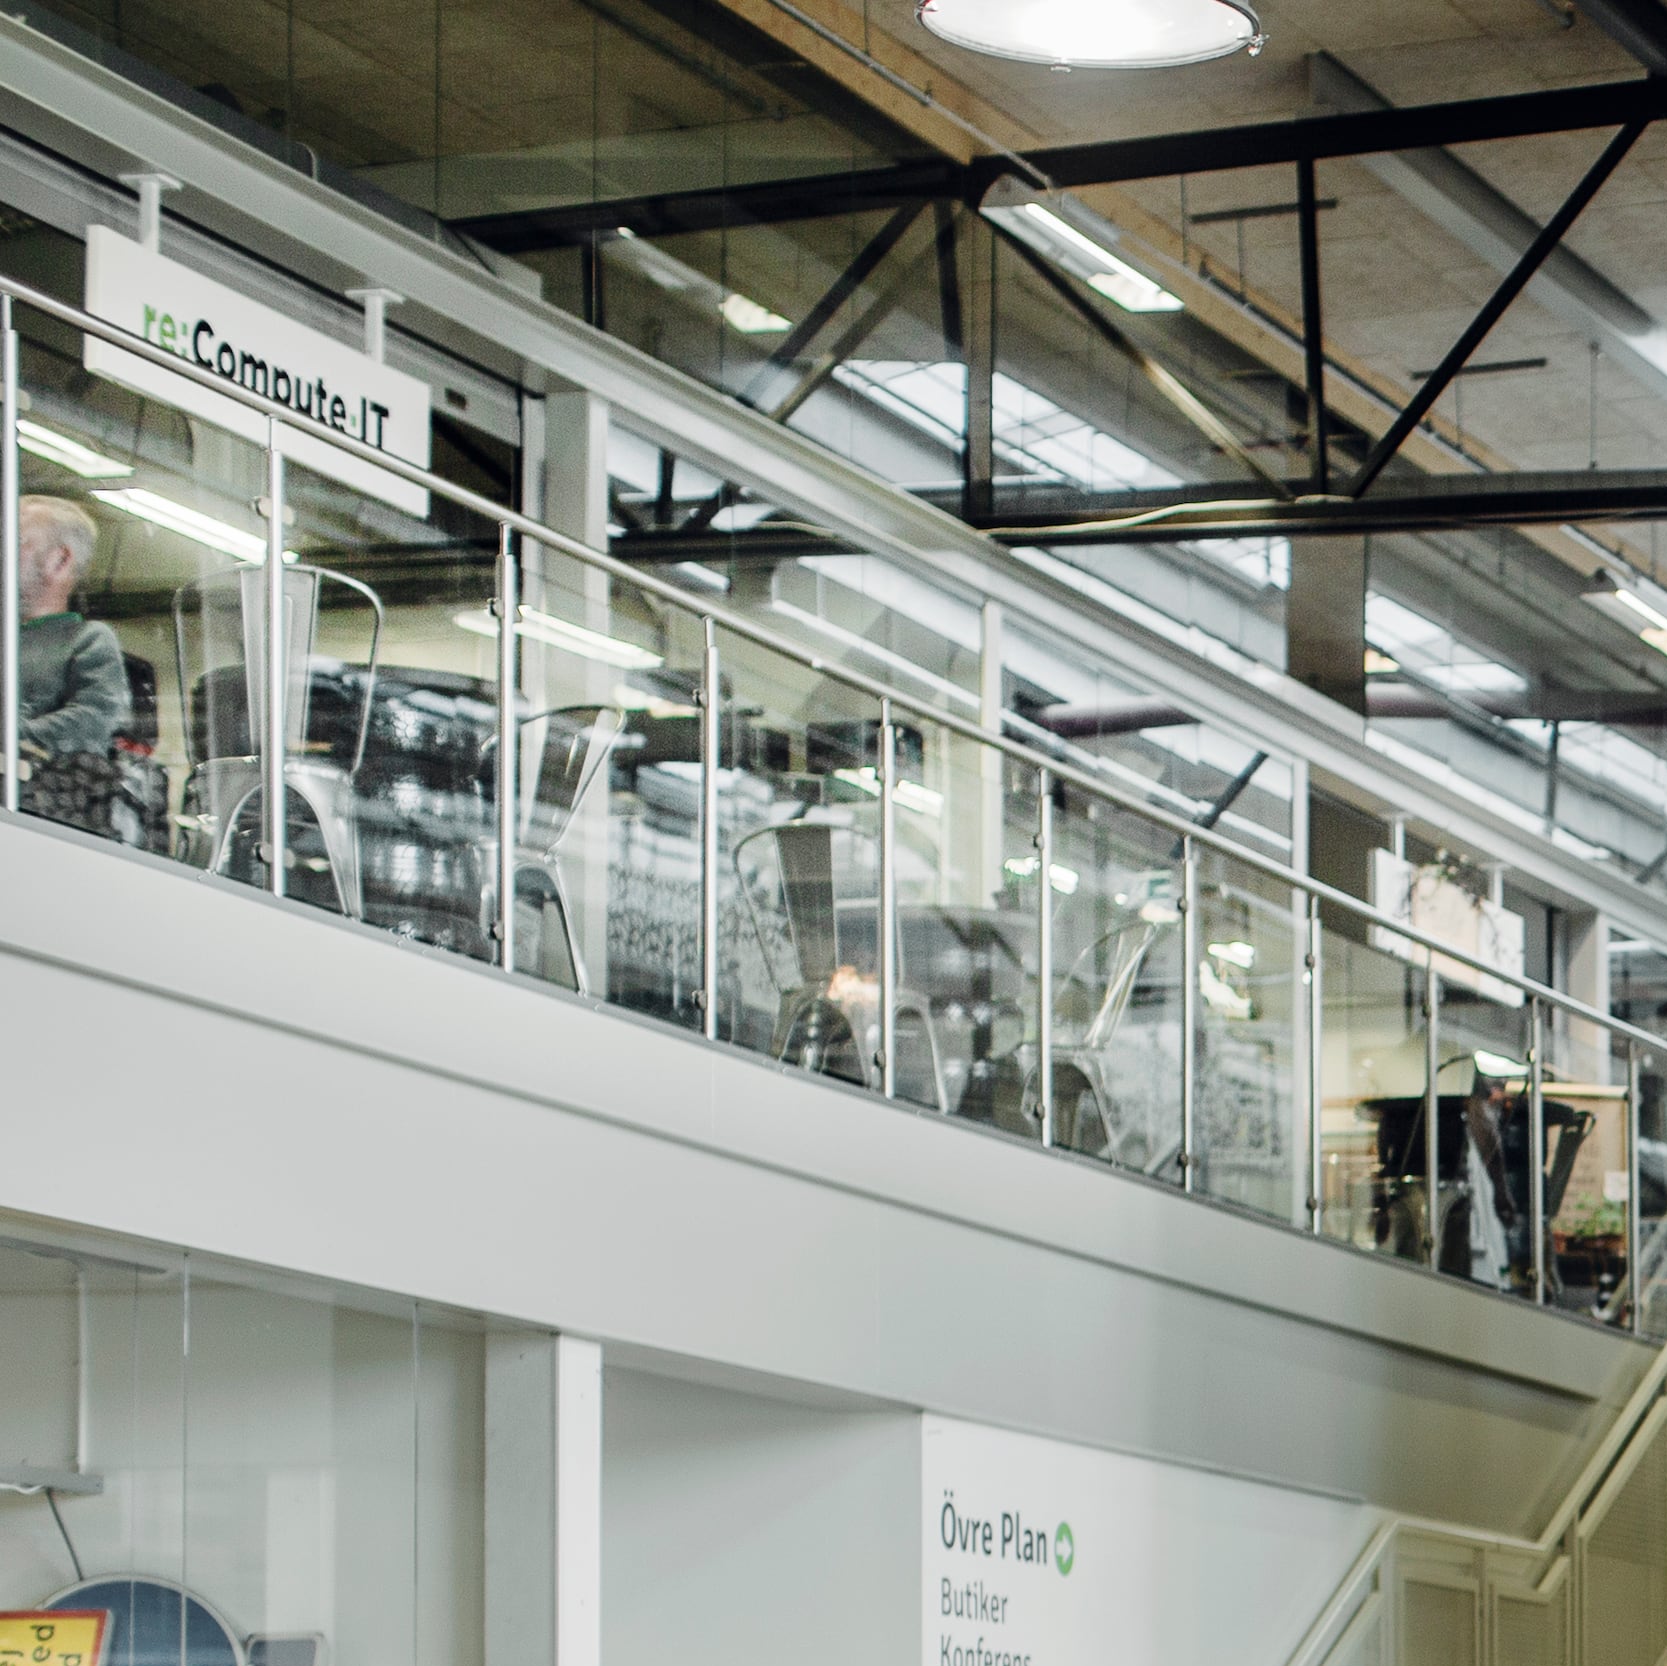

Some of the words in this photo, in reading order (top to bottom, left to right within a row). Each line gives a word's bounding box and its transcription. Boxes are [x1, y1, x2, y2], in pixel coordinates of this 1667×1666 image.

[940, 1490, 993, 1556] Övre
[1001, 1510, 1048, 1566] Plan
[941, 1577, 1008, 1625] Butiker
